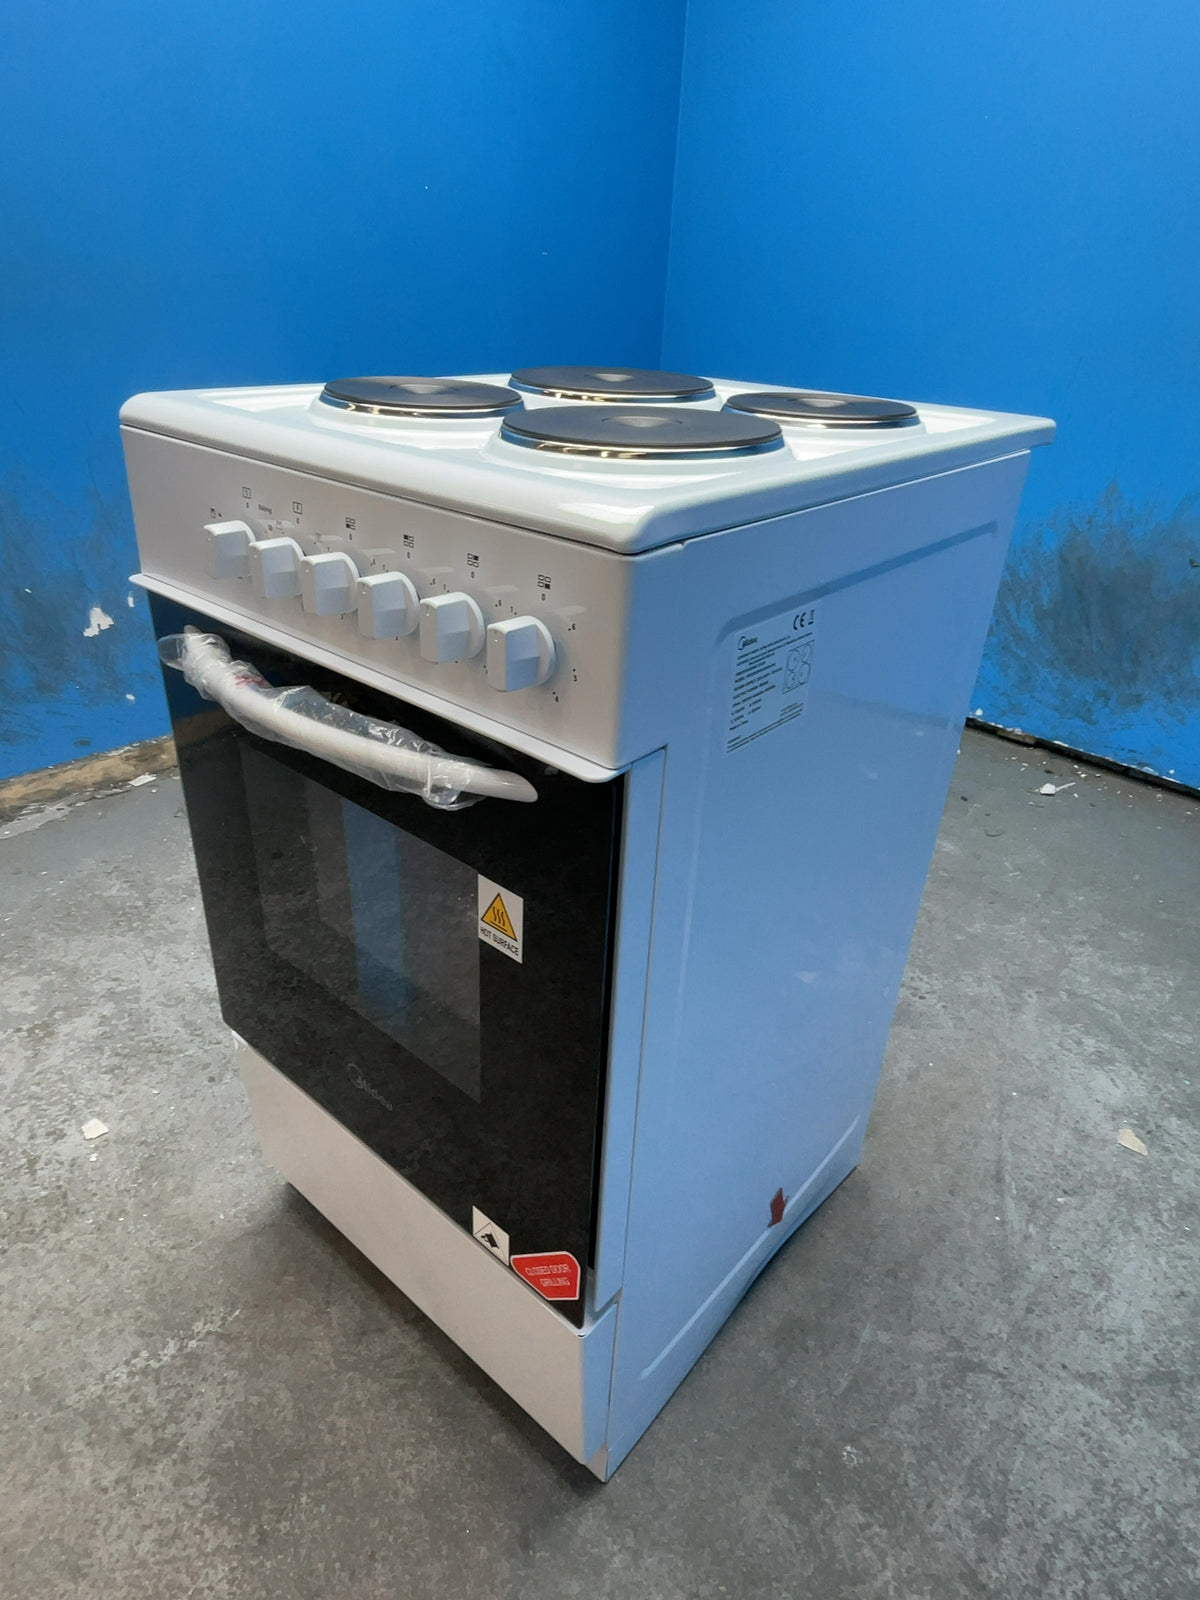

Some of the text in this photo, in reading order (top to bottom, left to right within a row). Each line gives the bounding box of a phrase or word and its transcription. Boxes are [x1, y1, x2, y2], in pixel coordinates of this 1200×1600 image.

[480, 926, 519, 956] HOT SURFACE
[525, 1263, 571, 1277] CLOSED DOOR
[540, 1276, 571, 1288] GRILLING
